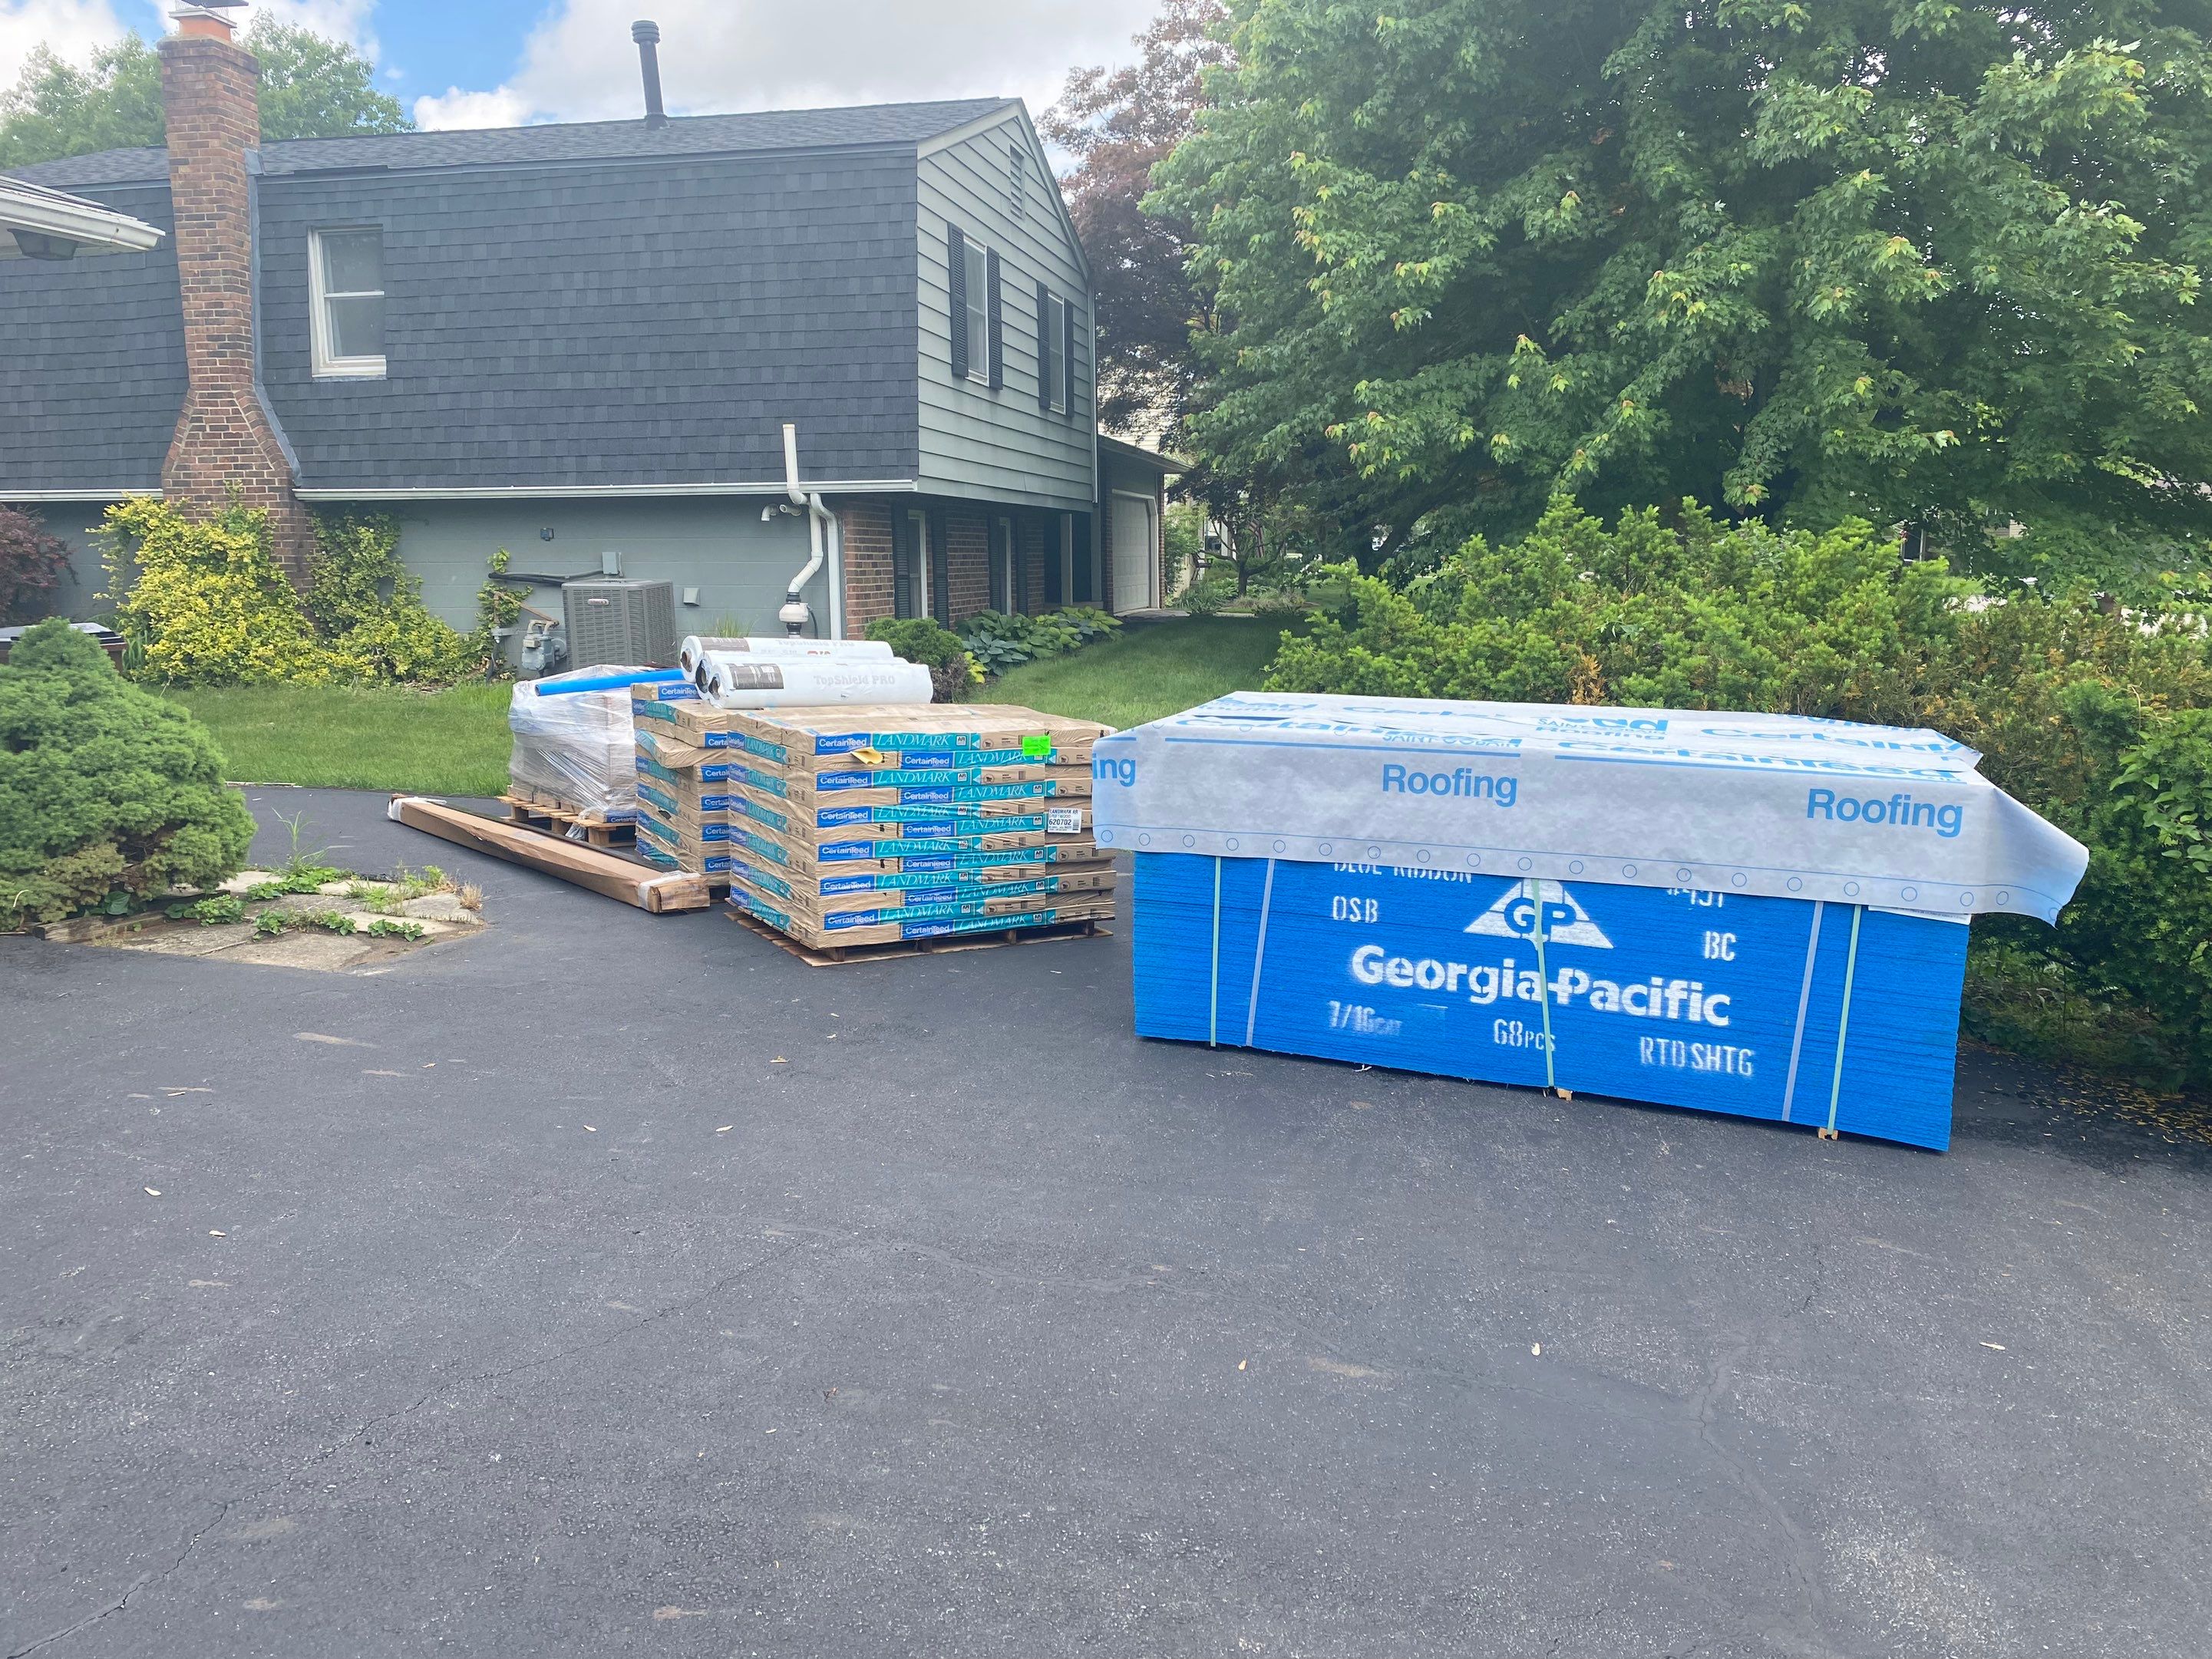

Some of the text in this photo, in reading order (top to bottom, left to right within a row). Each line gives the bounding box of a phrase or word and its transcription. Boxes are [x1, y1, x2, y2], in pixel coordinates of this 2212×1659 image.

[814, 675, 895, 686] TopShield PRO
[819, 738, 867, 747] CertainTeed
[877, 734, 952, 747] LANDMARK
[905, 756, 949, 765] CertainTeed
[820, 776, 868, 785] CertainTeed
[878, 772, 951, 783] LANDMARK
[1382, 763, 1518, 808] Roofing
[904, 792, 949, 800] CertainTeed
[959, 785, 1027, 798] LANDMARK
[820, 810, 868, 820] CertainTeed
[1806, 788, 1963, 838] Roofing
[906, 825, 951, 833] CertainTeed
[822, 846, 870, 855] CertainTeed
[879, 841, 951, 853] LANDMARK
[881, 872, 952, 887] LANDMARK
[1332, 895, 1378, 924] OSB
[1504, 897, 1577, 935] GP
[906, 924, 950, 935] CertainTeed
[1704, 931, 1737, 961] BC
